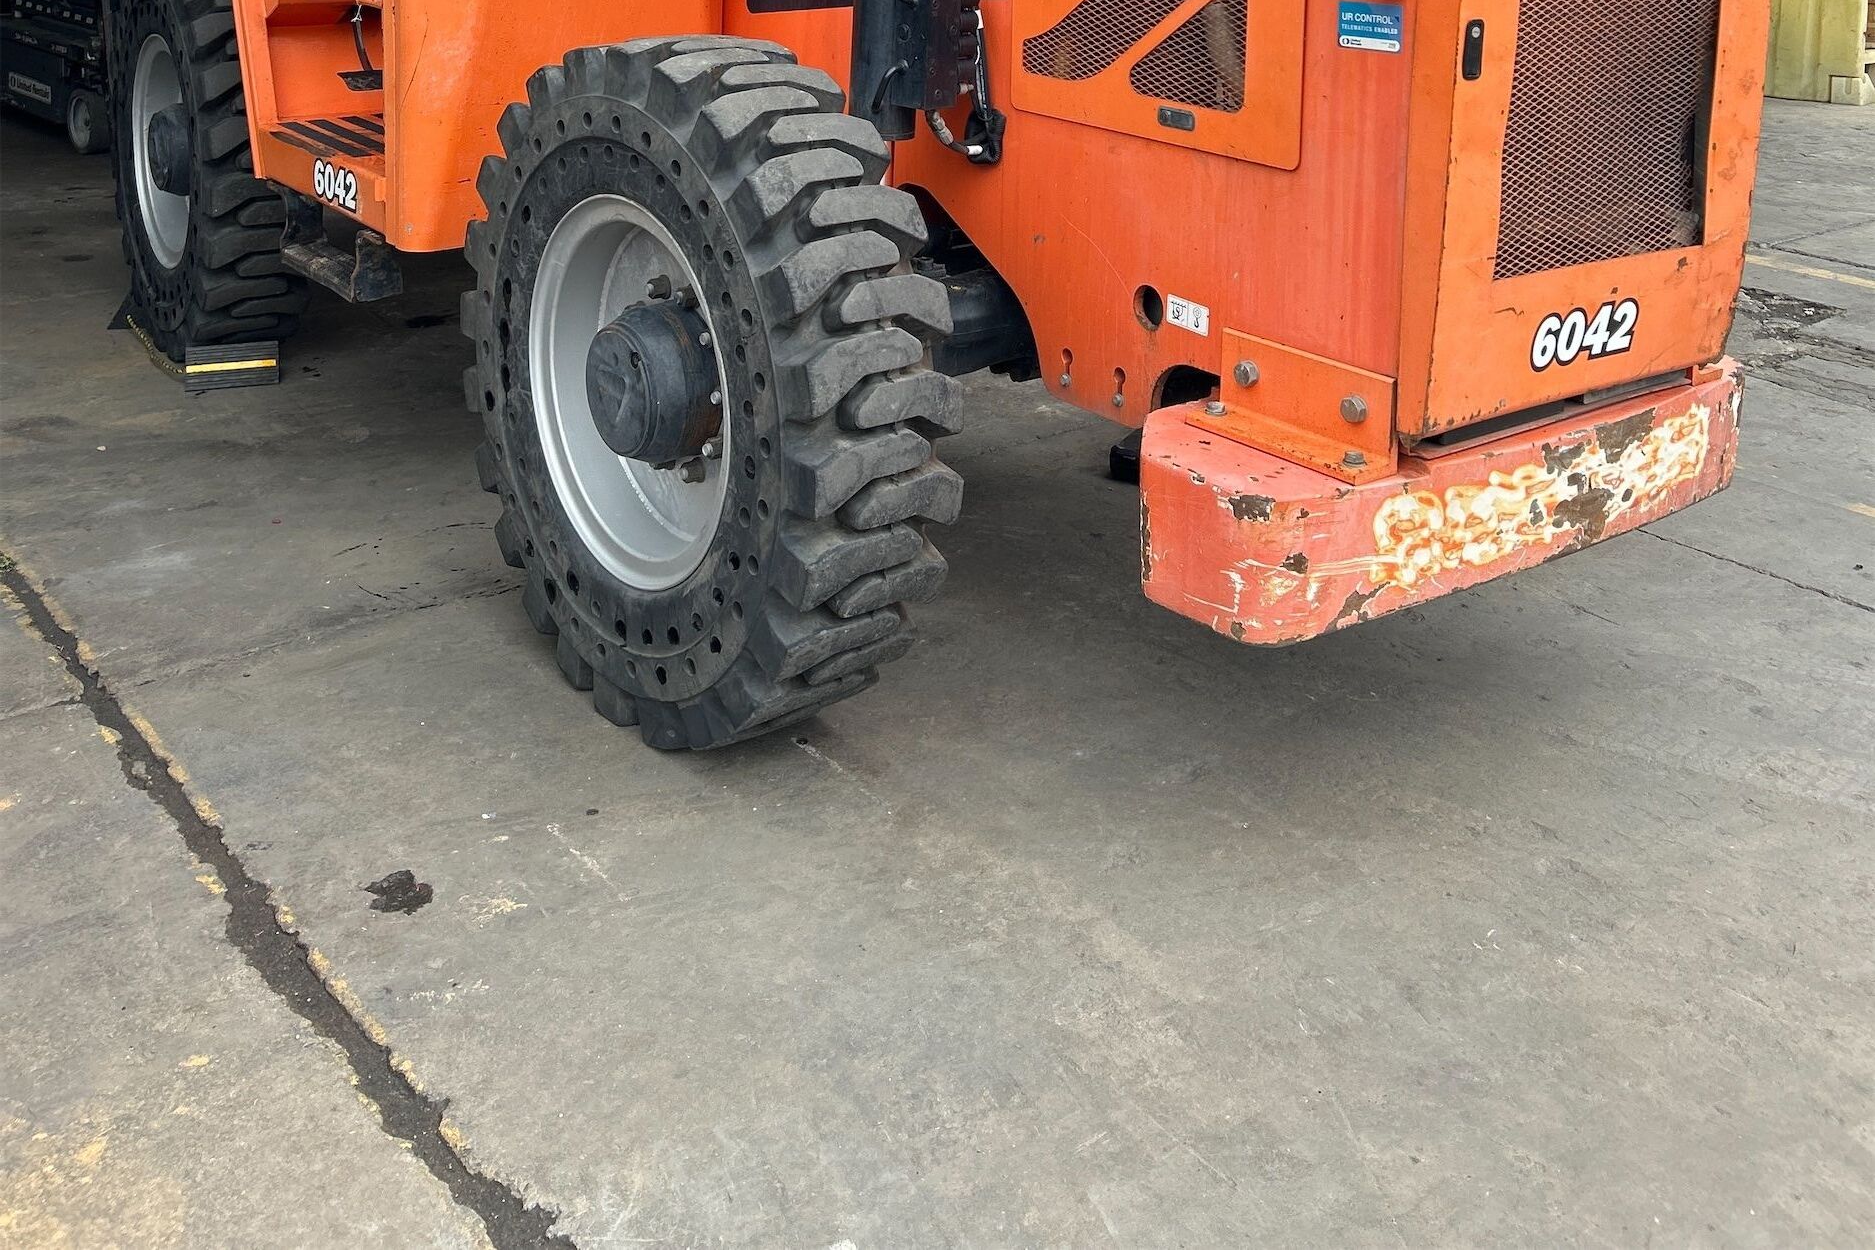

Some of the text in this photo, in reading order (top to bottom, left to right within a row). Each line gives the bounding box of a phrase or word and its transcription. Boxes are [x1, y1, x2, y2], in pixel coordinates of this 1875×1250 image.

[1341, 12, 1393, 25] UR CONTROL
[312, 157, 358, 215] 6042
[1530, 297, 1640, 372] 6042
